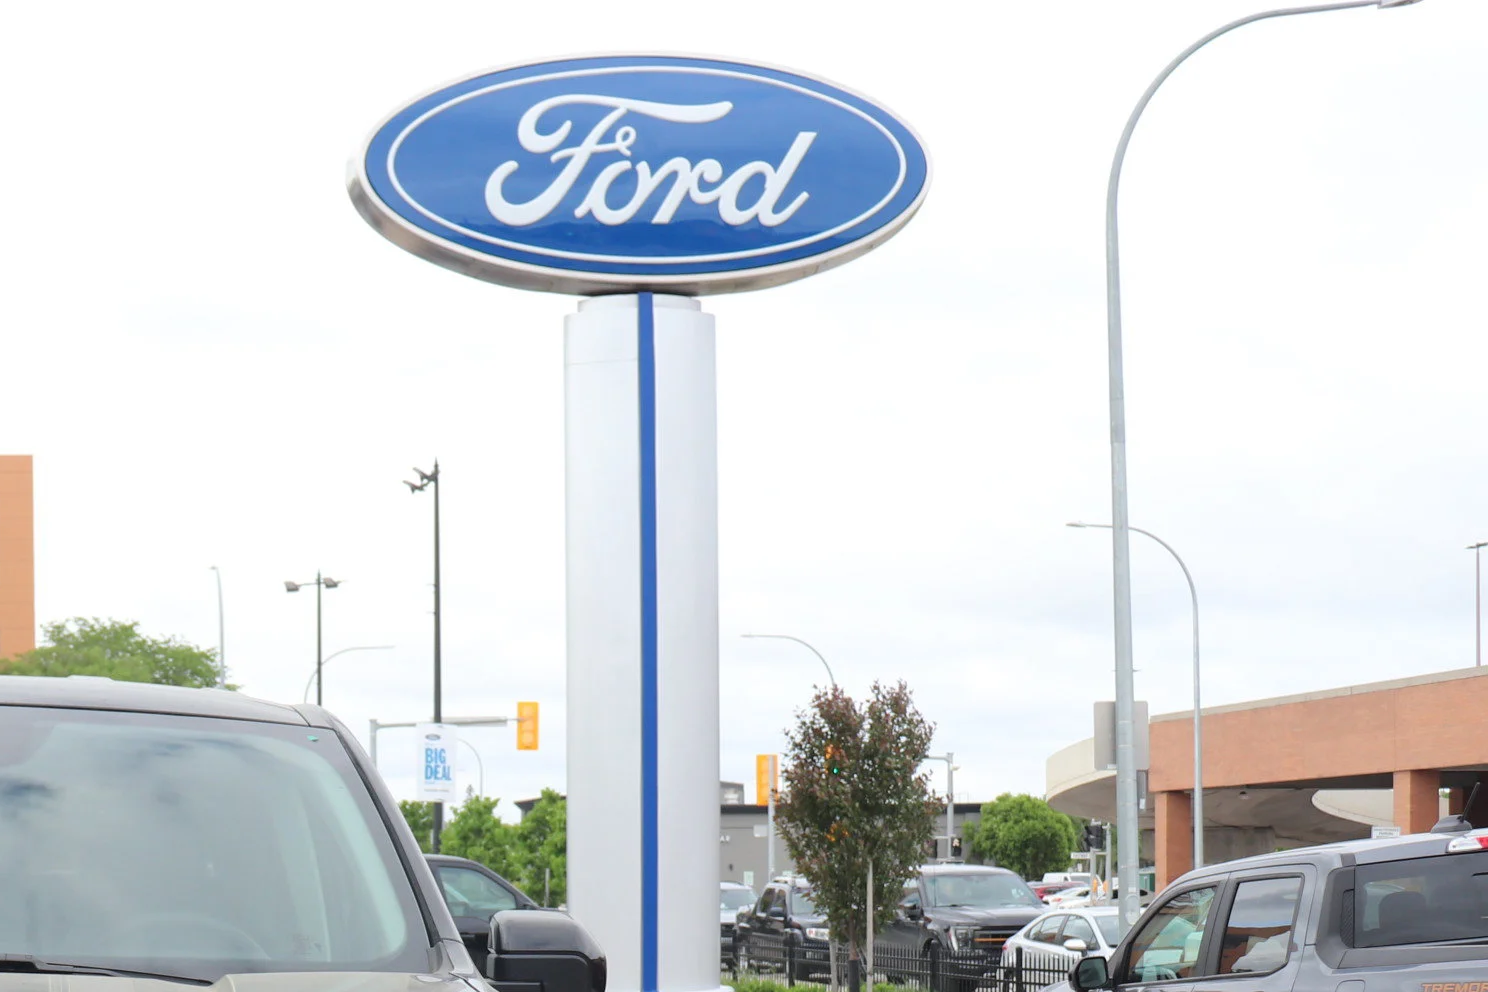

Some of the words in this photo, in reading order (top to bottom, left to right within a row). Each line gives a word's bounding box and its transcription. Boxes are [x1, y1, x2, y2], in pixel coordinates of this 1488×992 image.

[485, 94, 817, 227] Ford
[425, 748, 446, 764] BIG
[425, 765, 452, 780] DEAL
